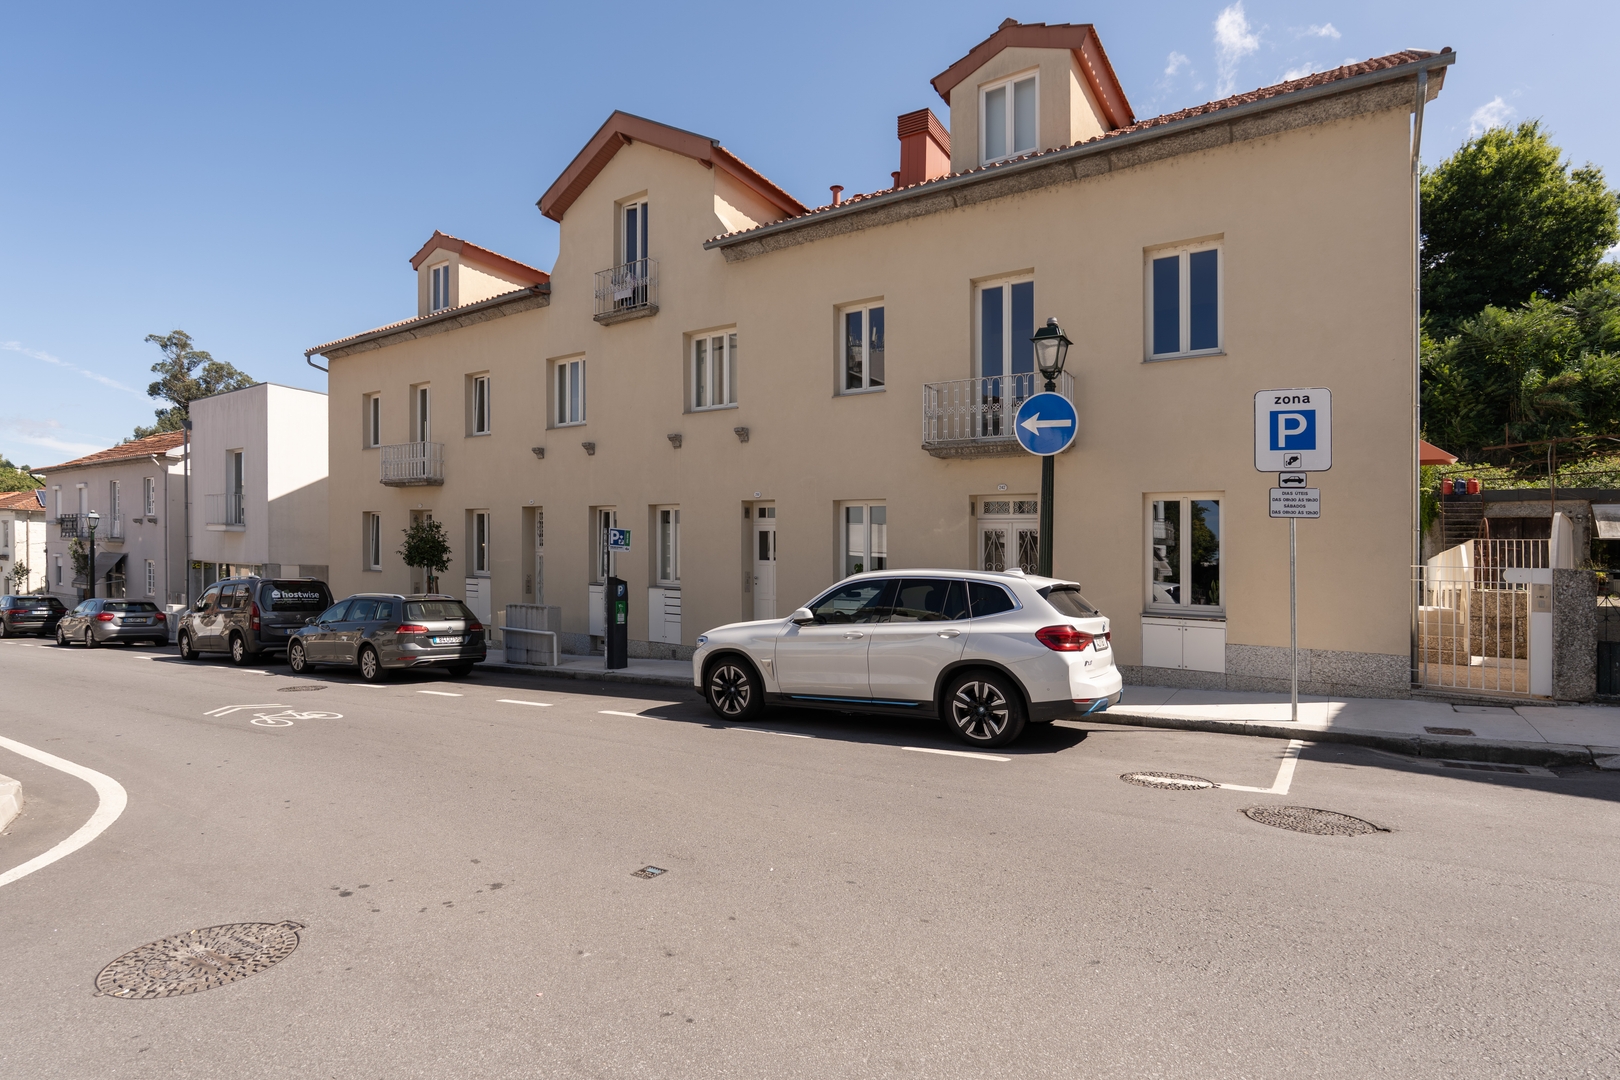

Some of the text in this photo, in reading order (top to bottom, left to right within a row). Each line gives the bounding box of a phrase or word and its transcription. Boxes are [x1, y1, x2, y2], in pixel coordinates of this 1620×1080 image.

[1274, 395, 1310, 404] zona
[1278, 413, 1307, 447] P
[610, 530, 620, 544] P
